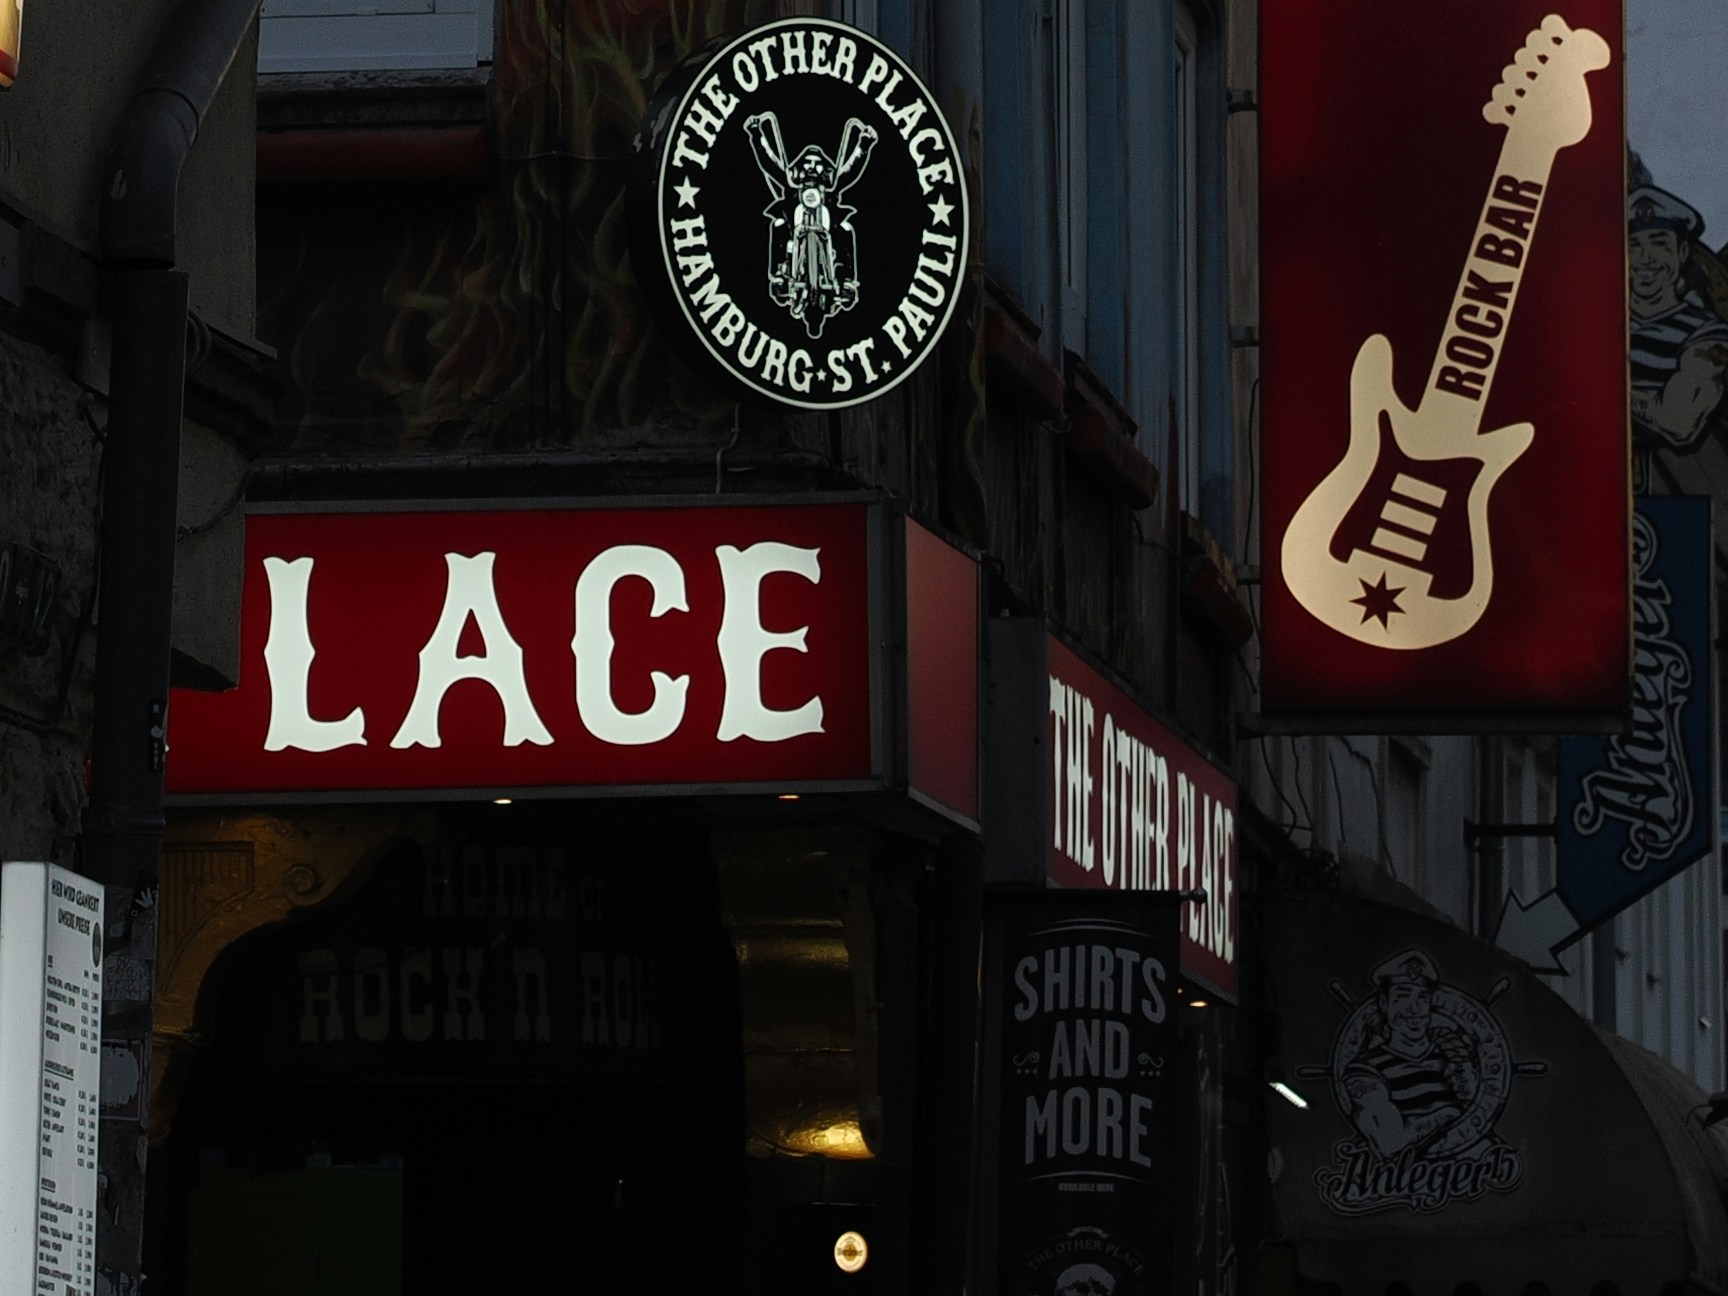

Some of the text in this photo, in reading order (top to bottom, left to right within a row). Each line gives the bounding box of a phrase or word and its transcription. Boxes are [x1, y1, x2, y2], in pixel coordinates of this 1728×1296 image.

[672, 30, 956, 196] THE OTHER PLACE
[669, 214, 815, 394] HAMBURG
[882, 229, 958, 360] PAULI
[1435, 174, 1544, 402] ROCK BAR
[262, 540, 828, 753] LACE
[1048, 672, 1234, 965] THE OTHER PLACE
[297, 945, 486, 1044] ROCK
[579, 949, 663, 1052] ROLL
[1013, 944, 1167, 1025] SHIRTS
[1048, 1018, 1130, 1082] AND
[1024, 1086, 1154, 1169] MORE
[1322, 1143, 1489, 1204] Anleger
